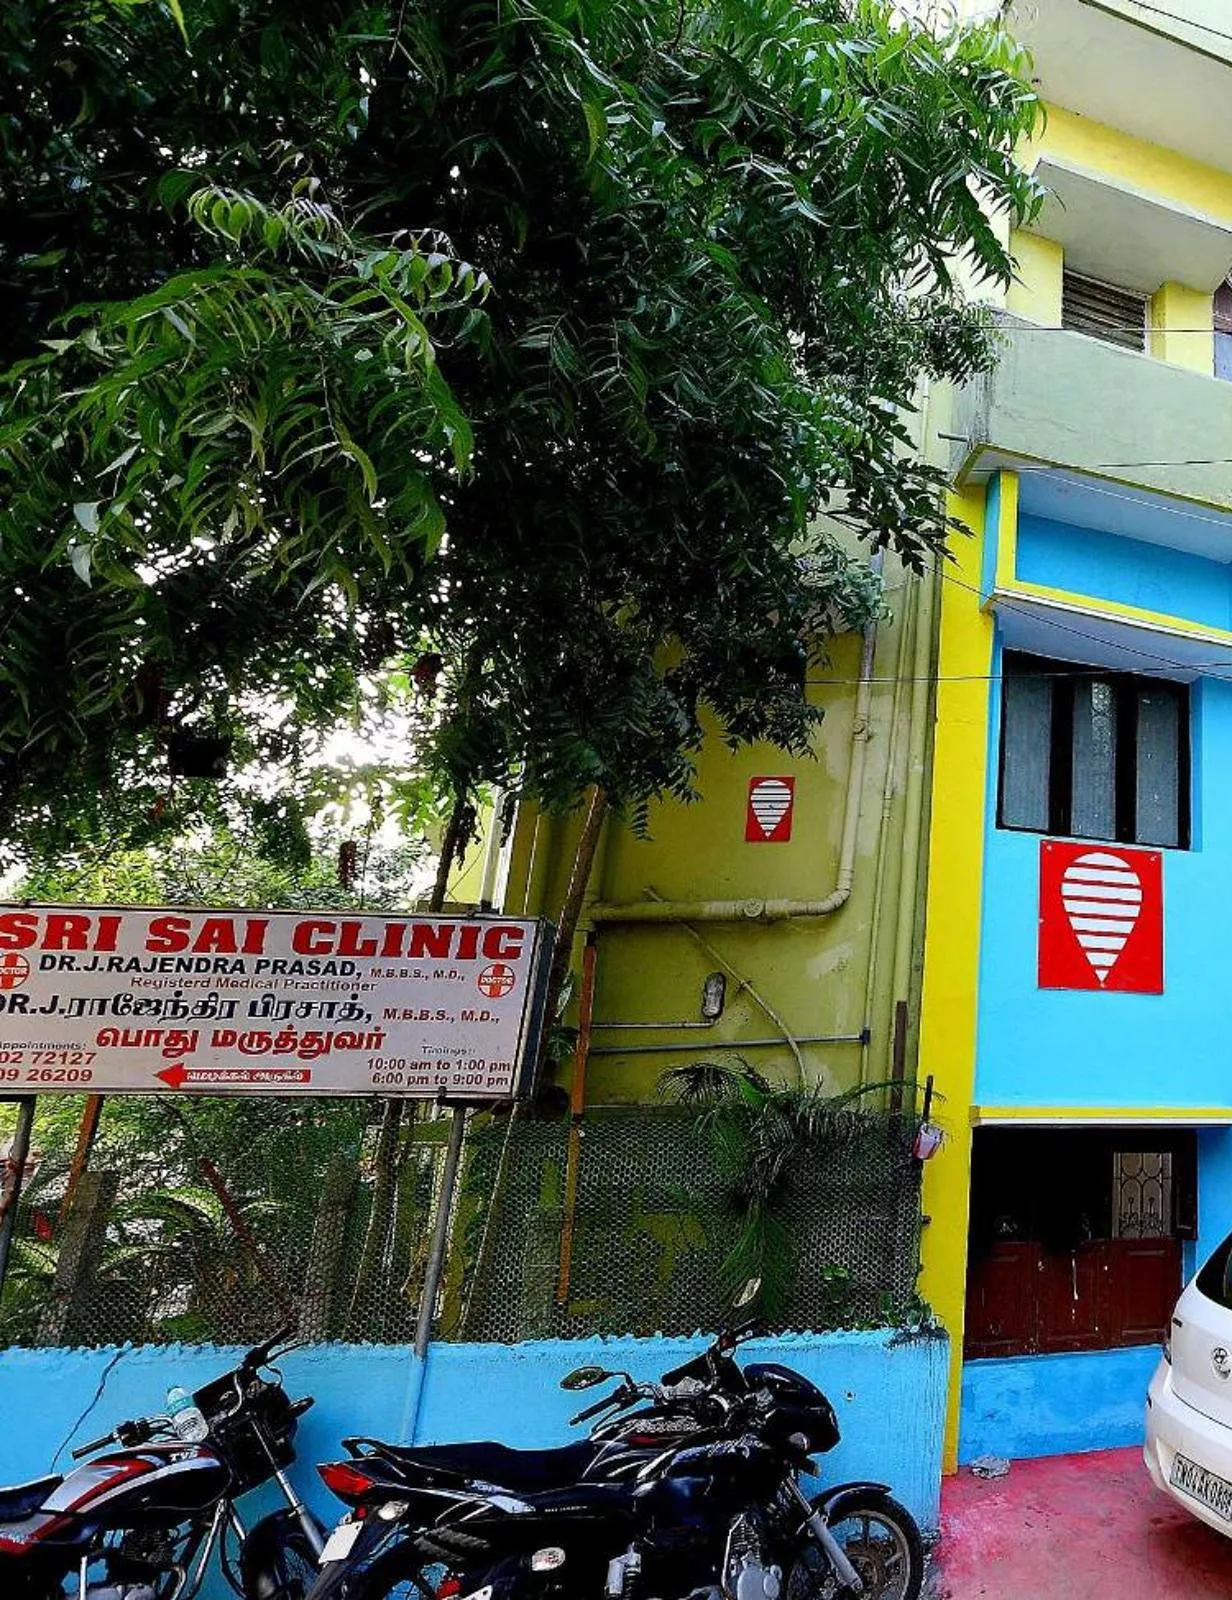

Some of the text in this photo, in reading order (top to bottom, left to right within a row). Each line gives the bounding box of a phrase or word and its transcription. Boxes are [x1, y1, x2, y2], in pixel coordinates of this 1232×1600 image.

[0, 913, 525, 960] SRI SAI CLINIC
[39, 954, 245, 975] DR.J.RAJENDRA
[254, 958, 362, 981] PRASAD,
[130, 976, 378, 992] Registerd Medical Practitioner
[96, 1024, 387, 1059] பொது மருத்துவர்
[31, 1051, 97, 1065] 72127
[367, 1058, 511, 1073] 10:00 am to 1:00 pm
[26, 1069, 93, 1082] 26209
[372, 1073, 509, 1088] 6:00 pm to 9:00 pm
